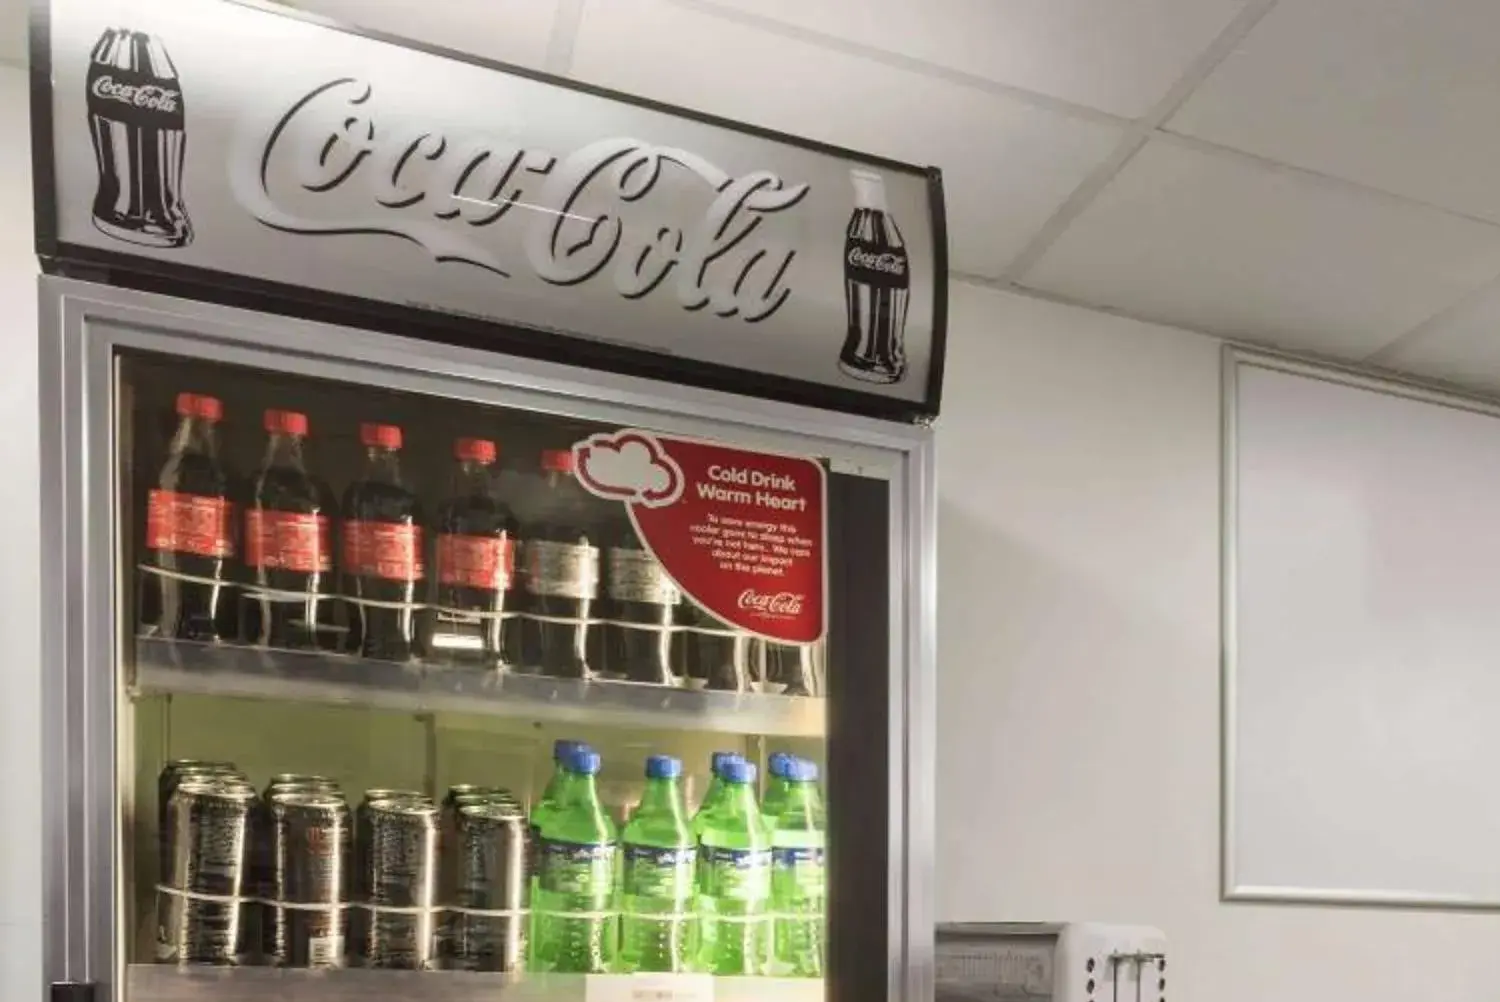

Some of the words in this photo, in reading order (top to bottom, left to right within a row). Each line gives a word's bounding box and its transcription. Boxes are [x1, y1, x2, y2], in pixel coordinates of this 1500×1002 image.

[707, 465, 748, 484] Cold
[751, 471, 796, 492] Drink
[696, 481, 752, 504] Warm
[755, 491, 807, 512] Heart
